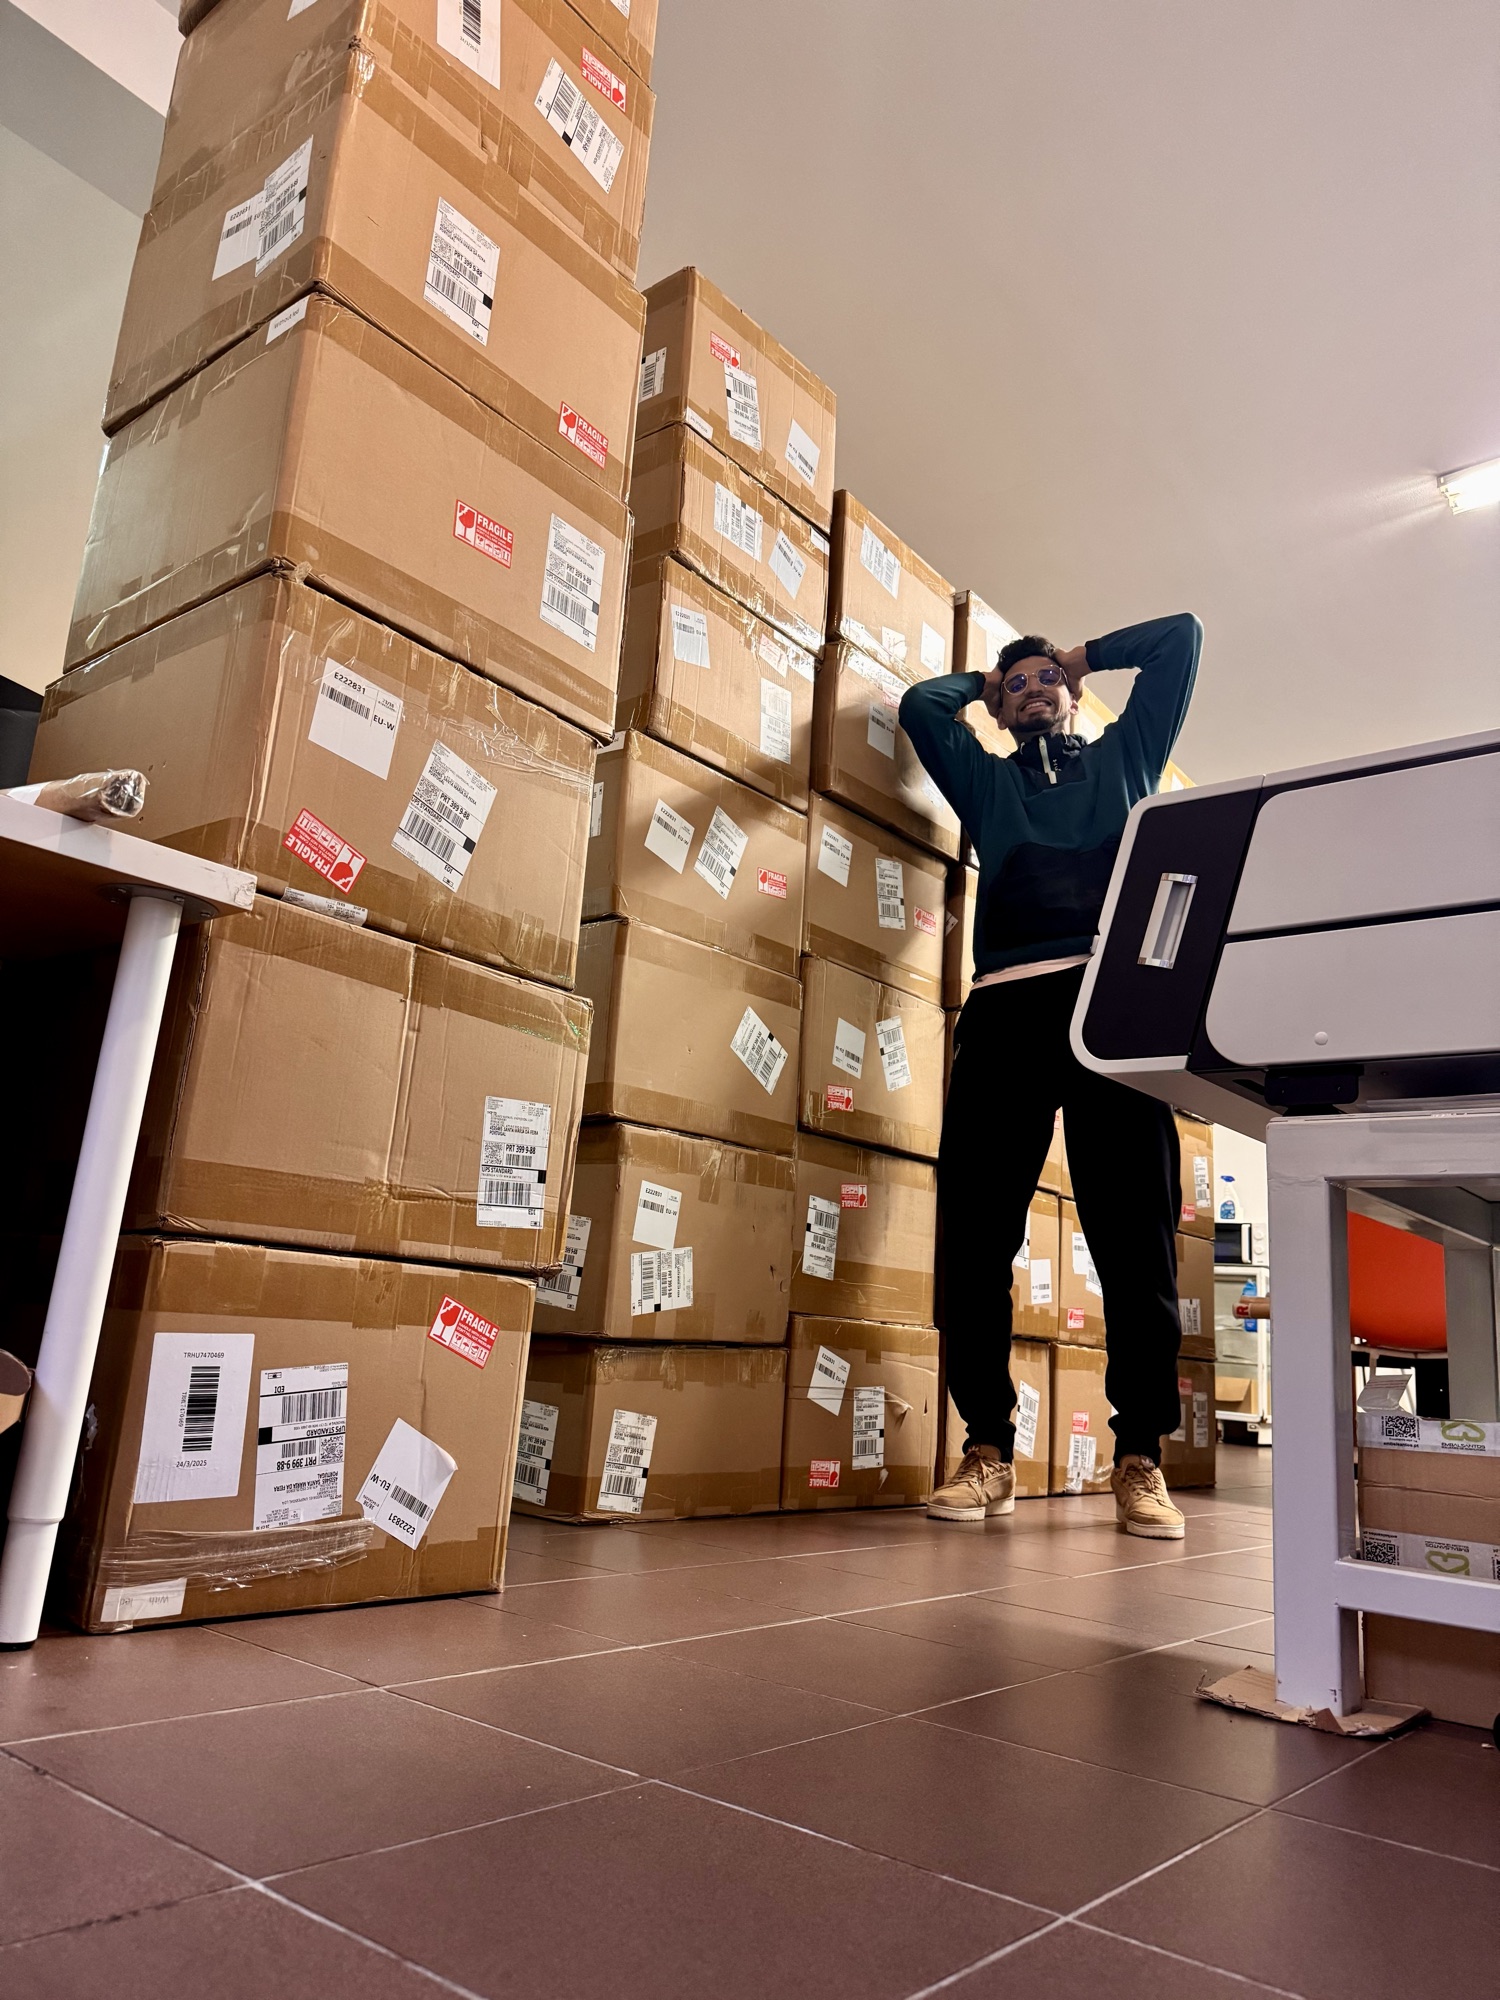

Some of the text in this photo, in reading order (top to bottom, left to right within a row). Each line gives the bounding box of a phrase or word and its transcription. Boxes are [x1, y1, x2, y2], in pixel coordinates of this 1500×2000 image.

[581, 66, 611, 101] FRAGILE
[454, 250, 483, 278] PRT 399 9-88
[578, 418, 608, 449] FRAGILE
[478, 514, 513, 544] FRAGILE
[334, 672, 366, 695] E222831
[373, 714, 394, 732] EU-W
[419, 802, 443, 822] STANDARD
[440, 792, 471, 820] PRT 399 9-88
[285, 833, 331, 875] FRAGILE
[768, 872, 787, 882] FRAGILE
[506, 1144, 536, 1155] PRT 399 9-88
[460, 1310, 498, 1340] FRAGILE
[274, 1385, 285, 1394] EDI
[306, 1426, 335, 1437] STANDARD
[335, 1425, 346, 1433] UPS
[176, 1460, 207, 1468] 24/3/2025
[276, 1457, 317, 1471] PRT 399 9-88
[293, 1481, 306, 1489] MARIA
[370, 1473, 391, 1491] EU-W
[388, 1512, 416, 1536] E222831
[1426, 1543, 1469, 1552] EMBALSANTOS
[120, 1596, 169, 1607] With led
